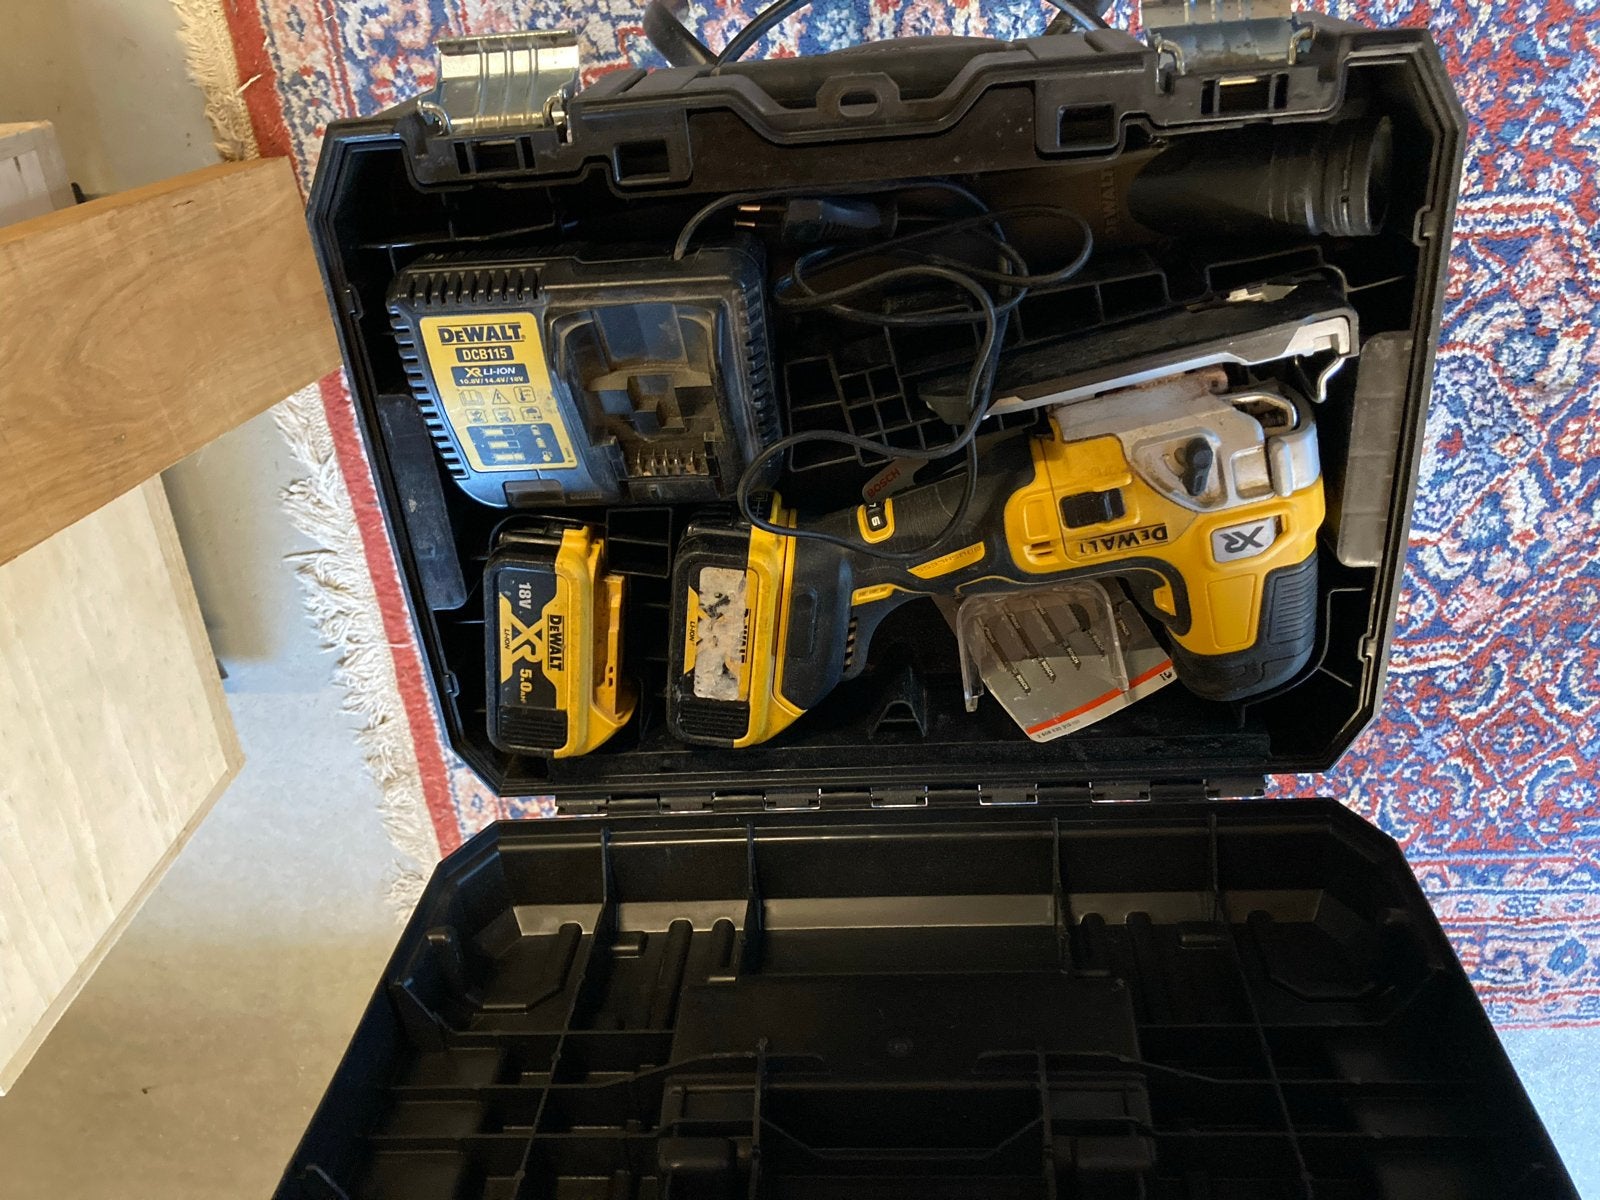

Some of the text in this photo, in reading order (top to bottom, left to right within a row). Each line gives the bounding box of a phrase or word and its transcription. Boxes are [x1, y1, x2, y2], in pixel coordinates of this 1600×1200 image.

[437, 324, 523, 344] DEWALT
[462, 348, 508, 361] DCB115
[465, 367, 516, 378] XR LI-ION
[867, 468, 901, 497] BOSCH
[1220, 526, 1265, 554] XR
[518, 582, 532, 610] 18V
[511, 614, 543, 664] XR
[548, 614, 563, 672] DEWALT
